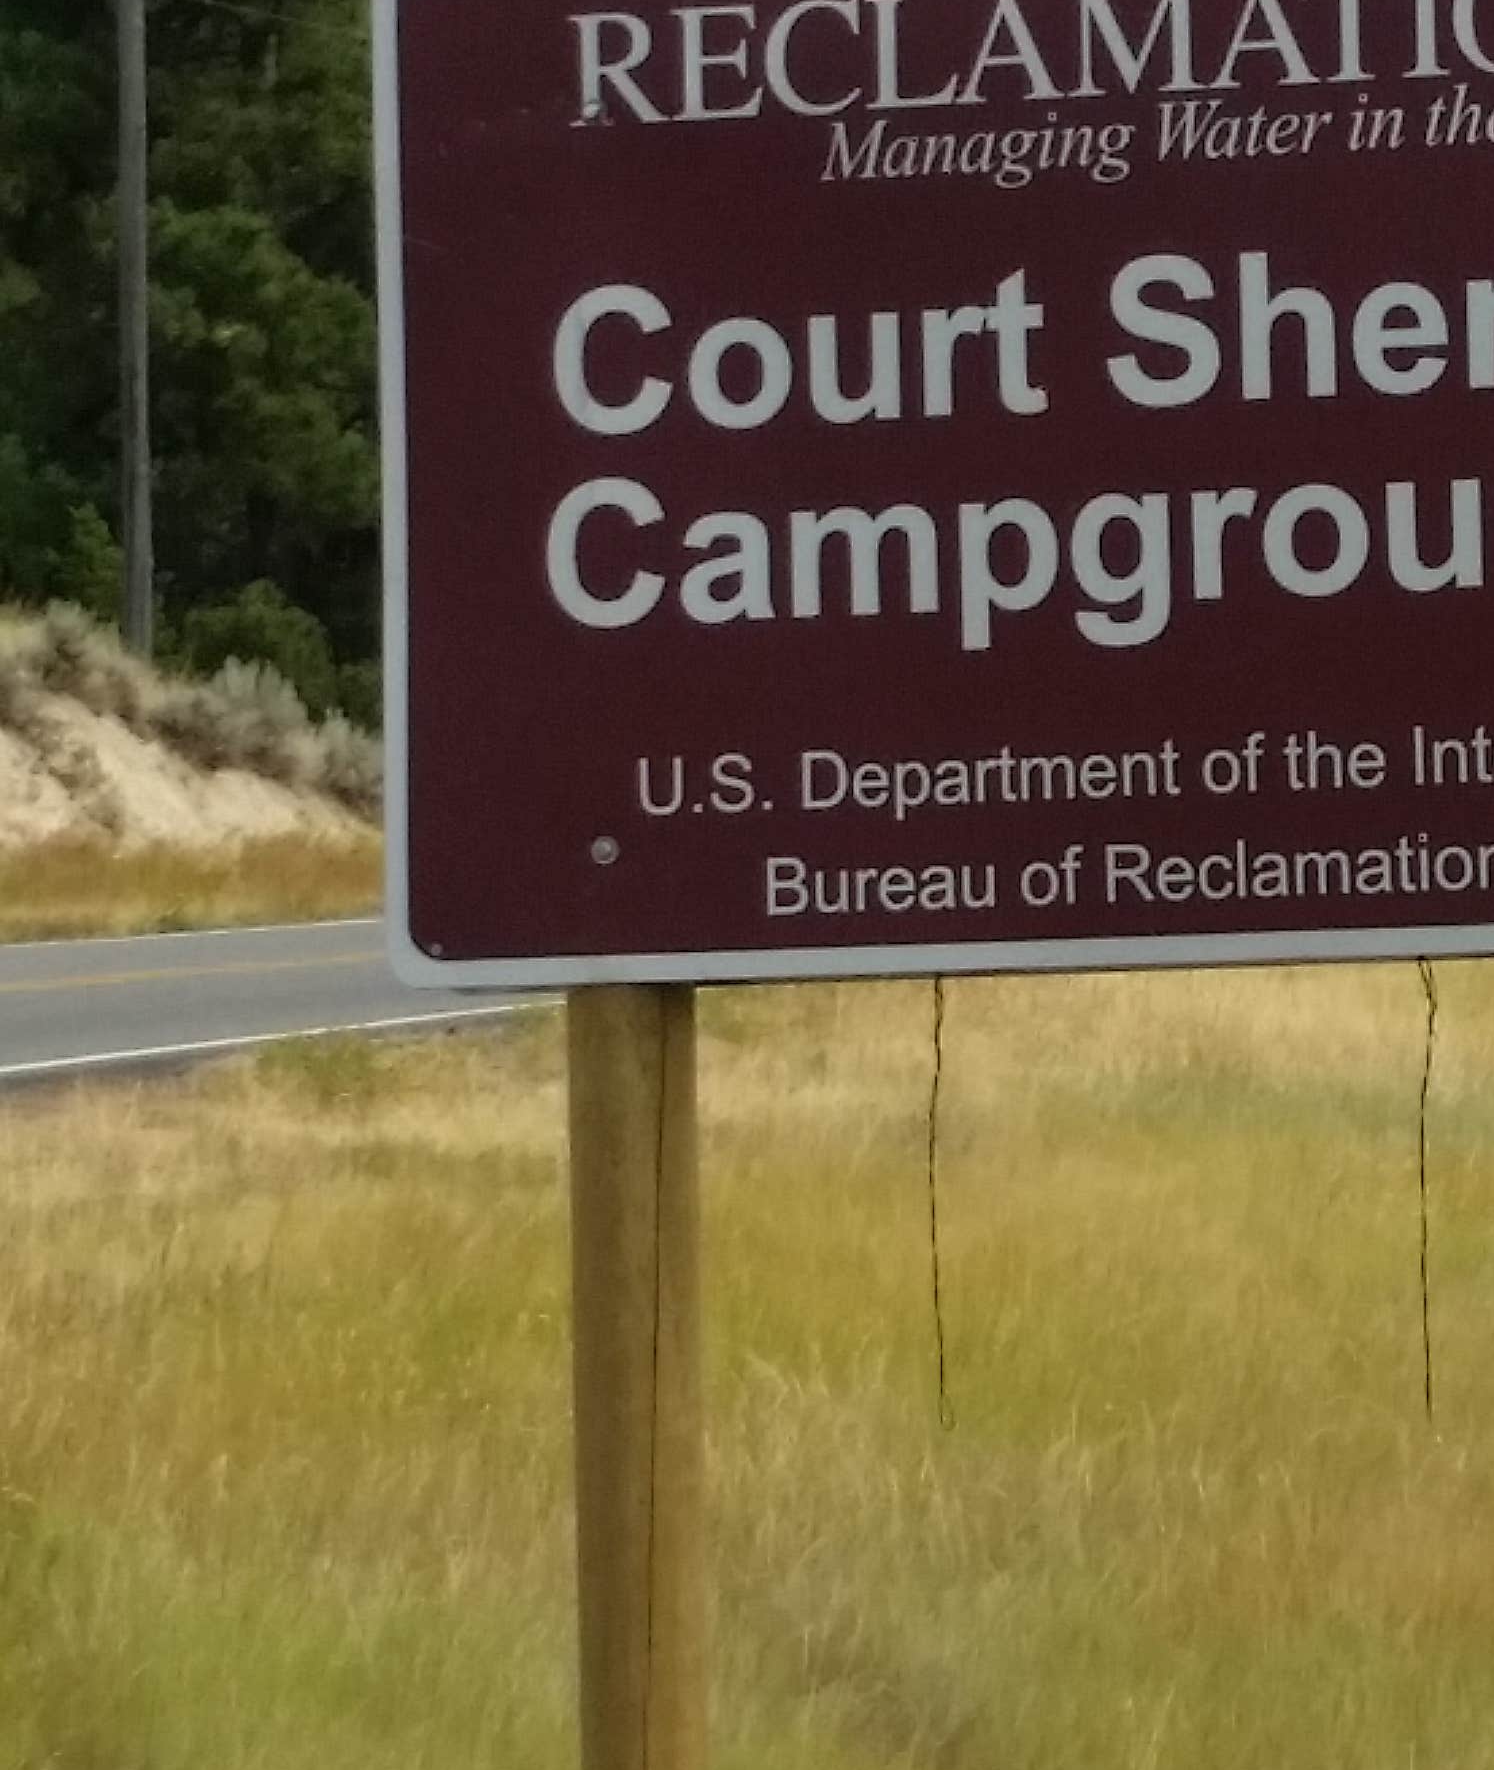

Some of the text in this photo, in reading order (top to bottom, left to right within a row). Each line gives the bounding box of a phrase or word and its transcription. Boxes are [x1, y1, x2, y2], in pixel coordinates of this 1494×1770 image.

[820, 106, 1136, 187] Managing
[1154, 98, 1336, 161] Water
[1347, 89, 1407, 151] in
[552, 266, 1049, 436] Court
[637, 753, 775, 817] U.S.
[800, 739, 1183, 822] Department
[1202, 732, 1267, 796] of
[1282, 728, 1387, 791] the
[765, 853, 997, 917] Bureau
[1020, 845, 1085, 907] of
